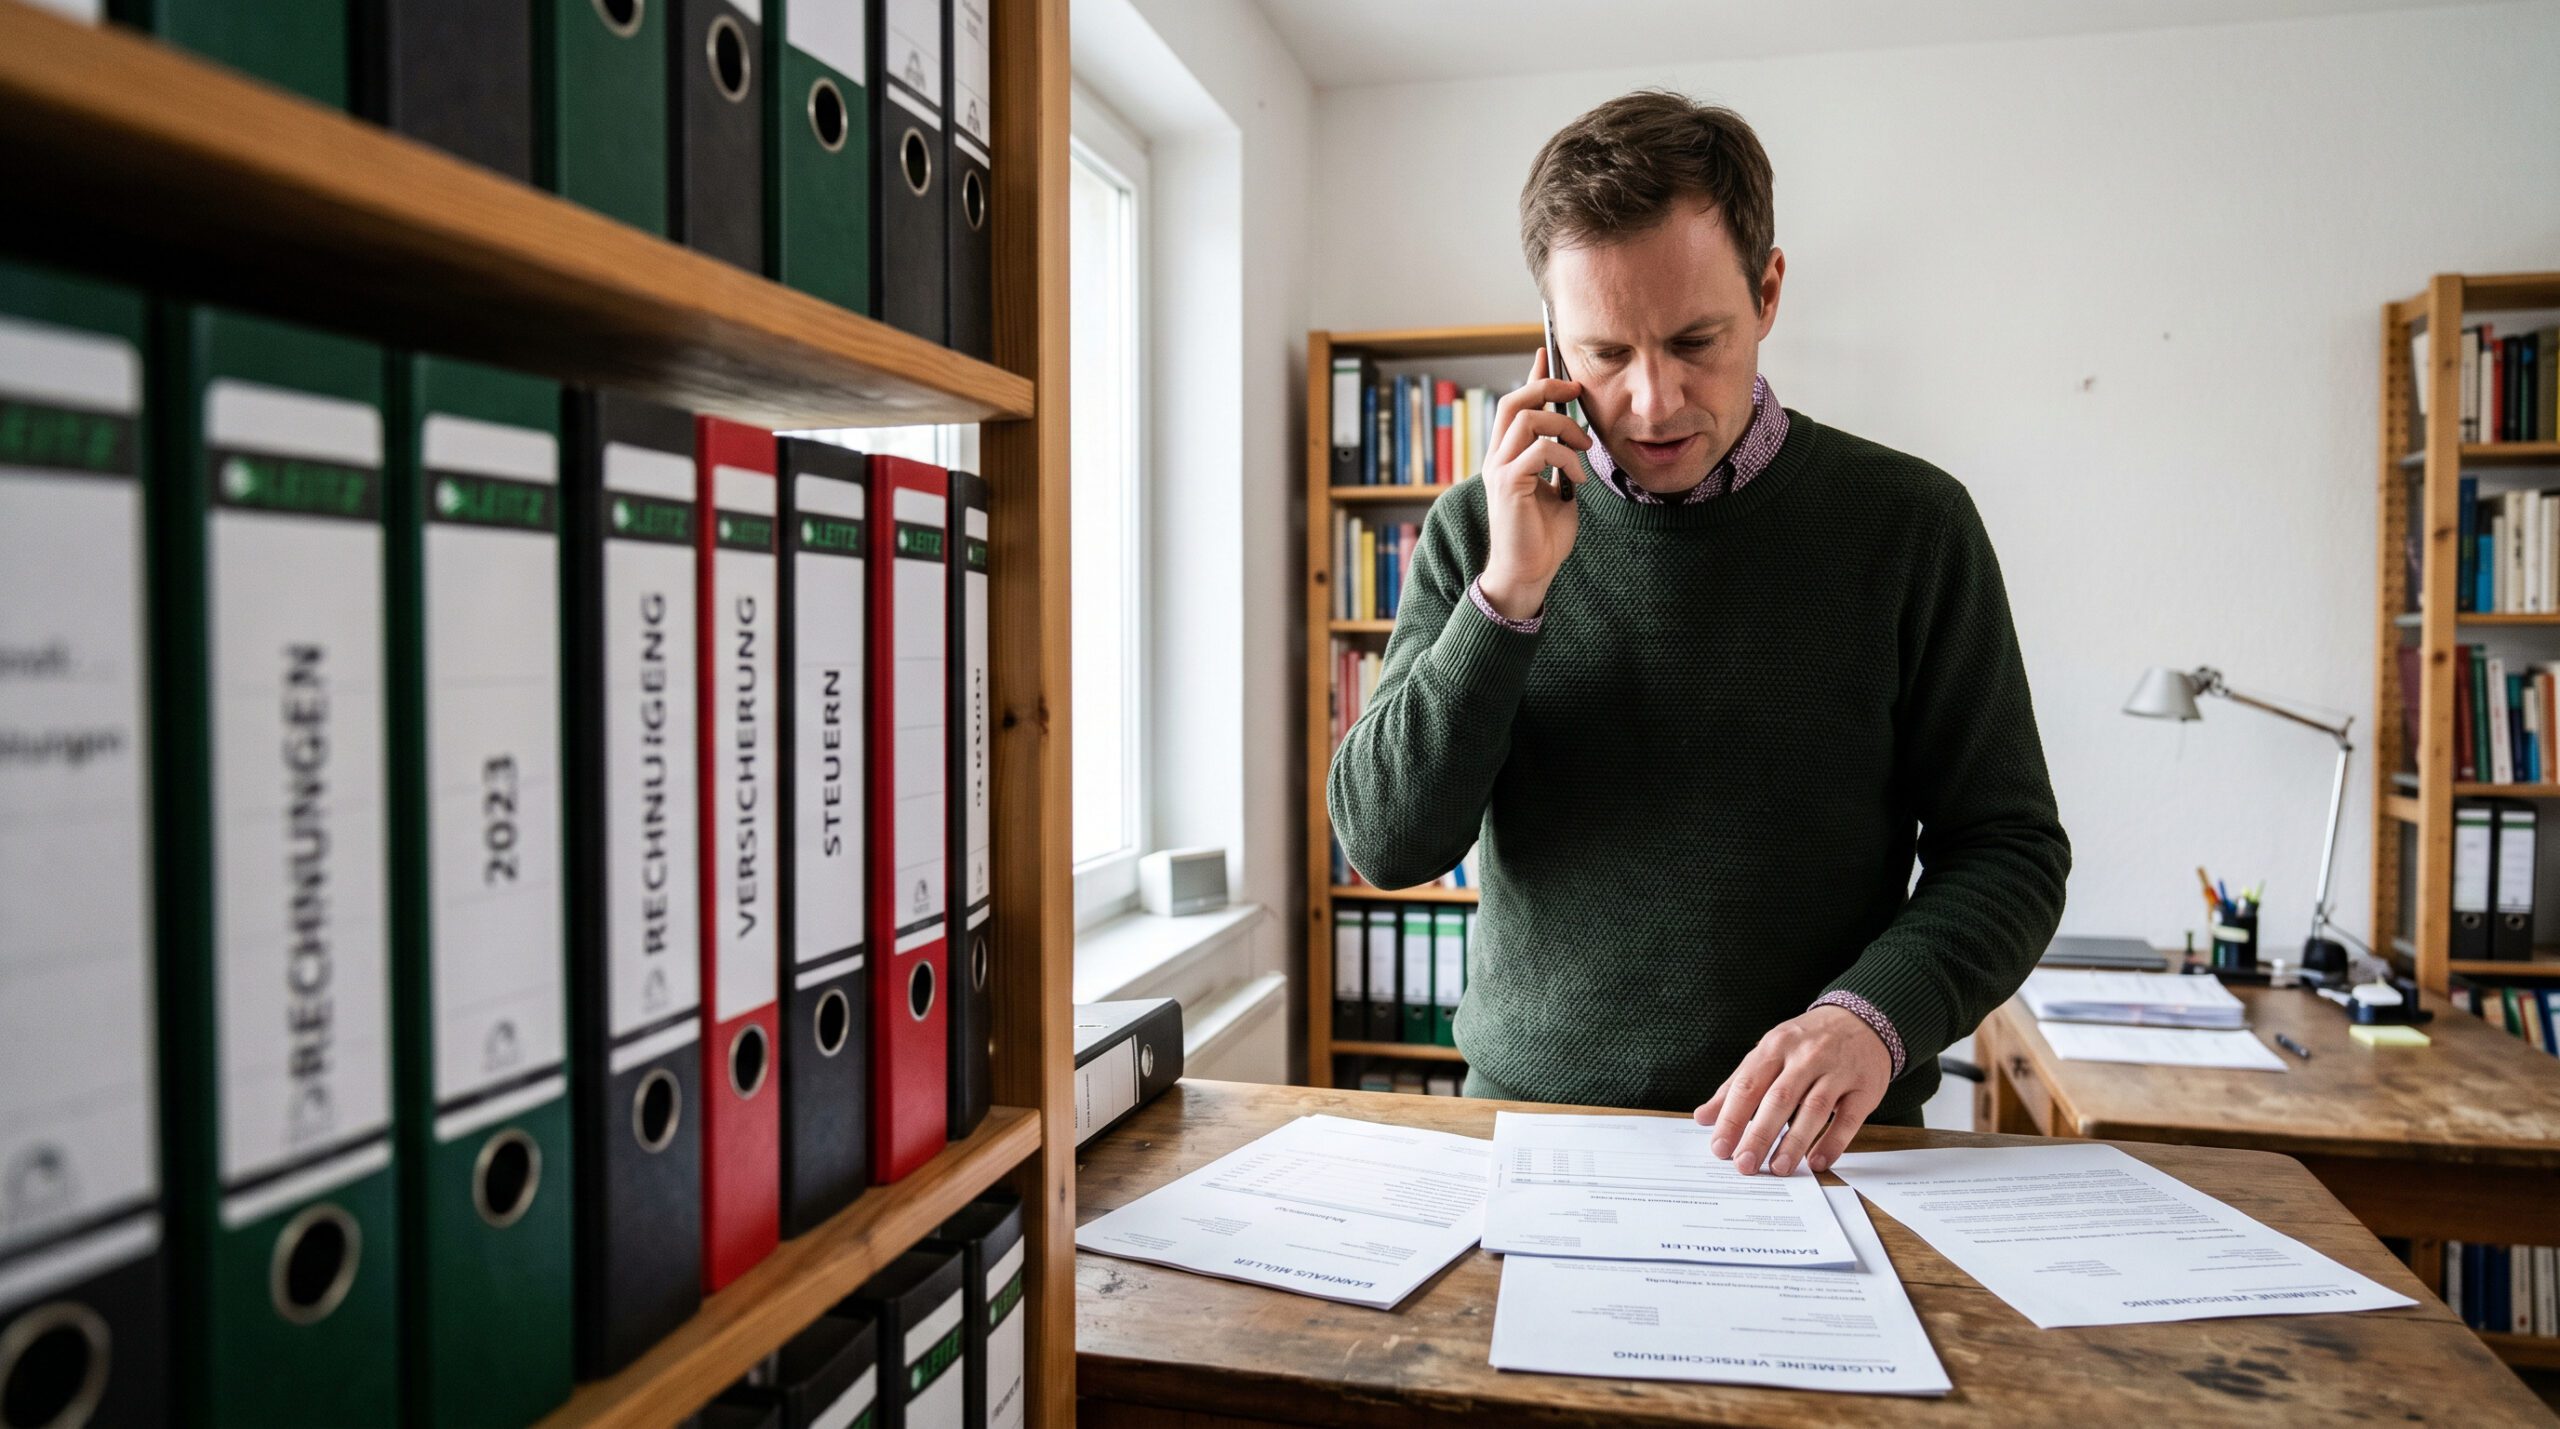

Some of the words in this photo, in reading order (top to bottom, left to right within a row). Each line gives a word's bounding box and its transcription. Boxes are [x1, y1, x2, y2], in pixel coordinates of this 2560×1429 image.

[631, 504, 687, 538] LEITZ
[816, 523, 858, 549] LEITZ
[908, 530, 941, 555] LEITZ
[736, 596, 757, 940] VERSICHERUNG
[823, 670, 841, 858] STEUERN
[482, 754, 519, 885] 2023
[283, 643, 332, 1083] RECHNUNGEN
[1661, 1242, 1726, 1253] MÜLLER
[1730, 1246, 1819, 1255] BANKHAUS
[1233, 1257, 1294, 1275] MÜLLER
[1775, 1360, 1897, 1374] ALLGEMEINE
